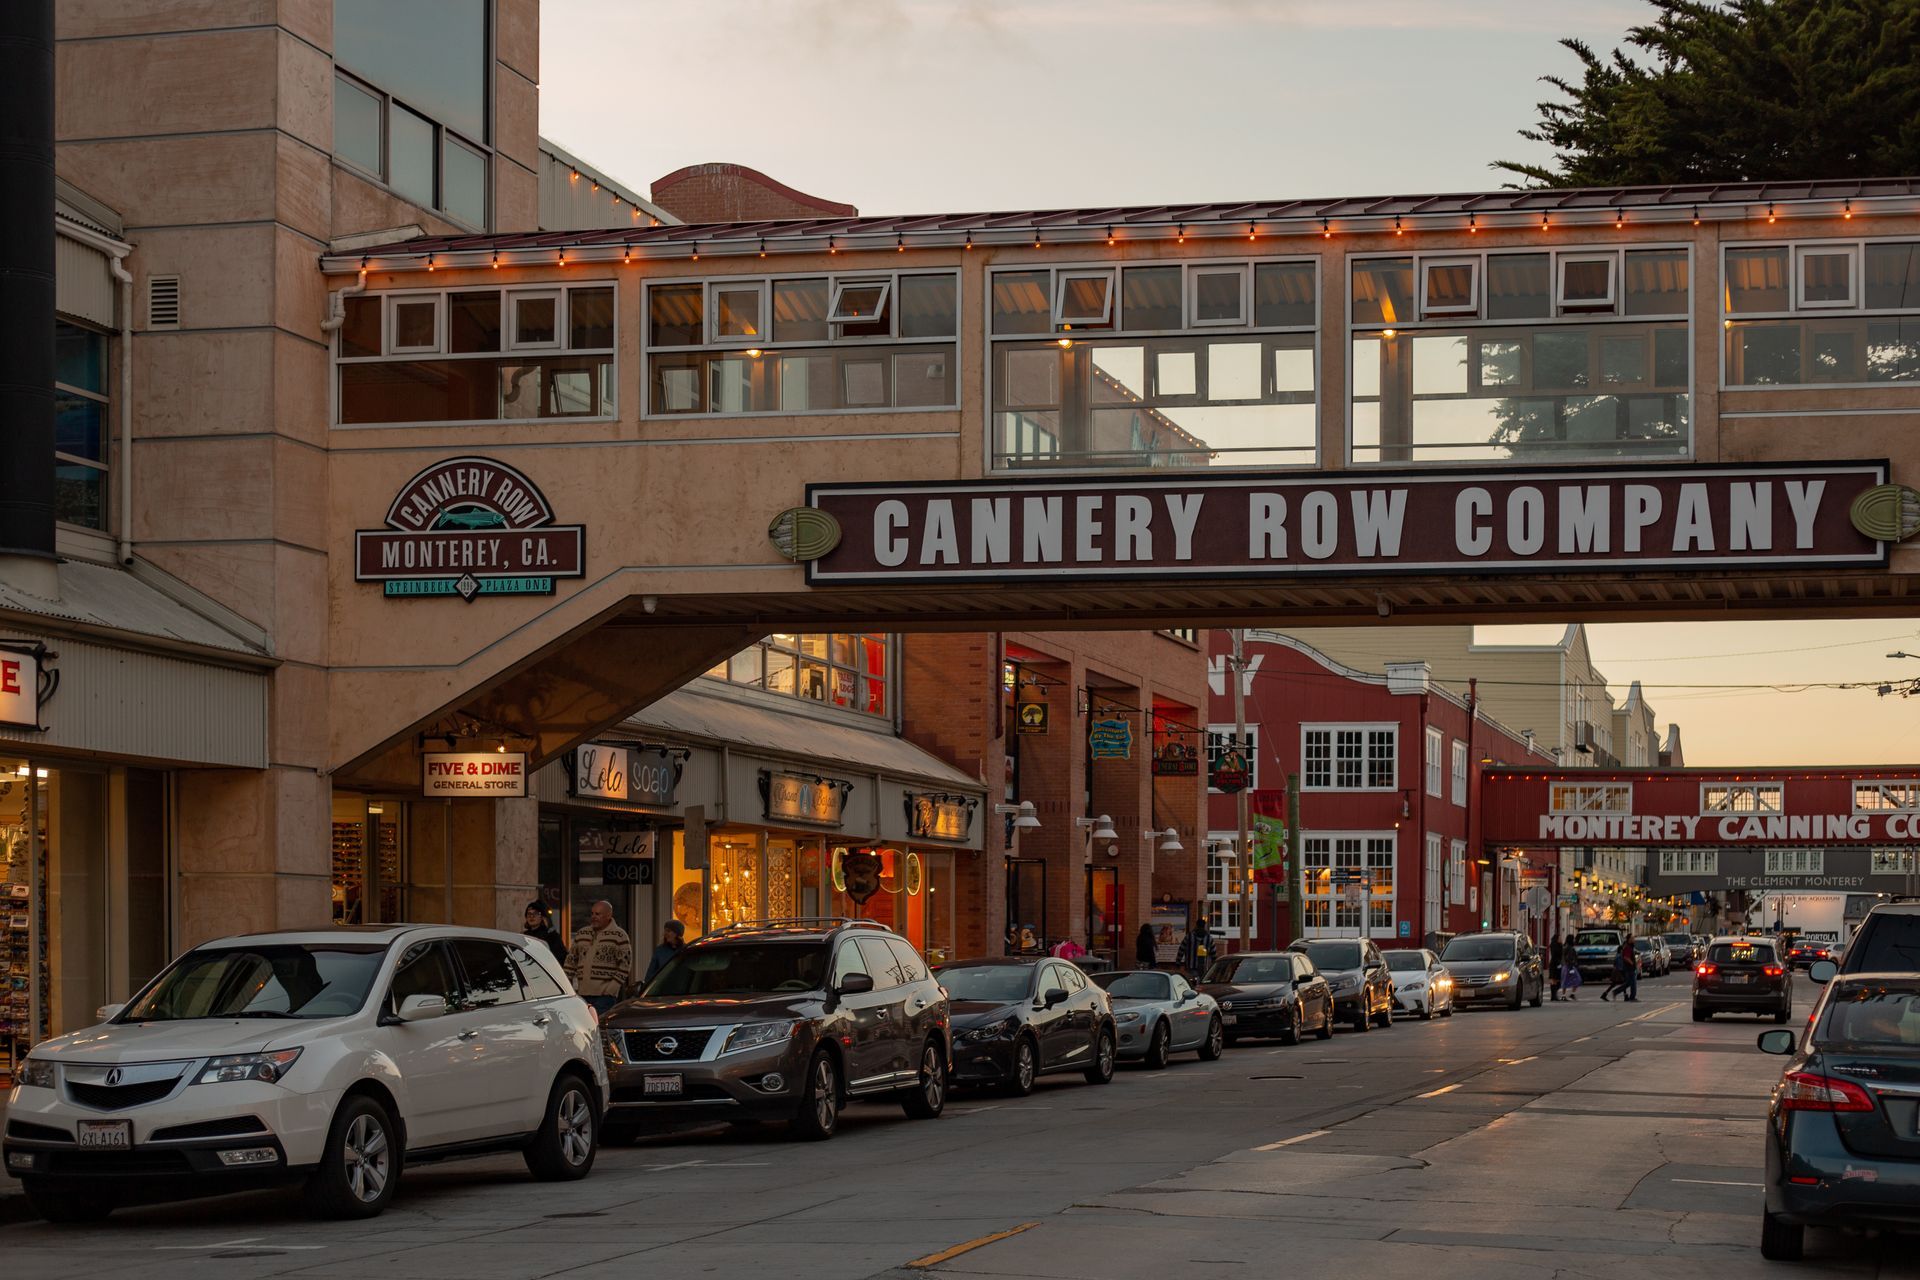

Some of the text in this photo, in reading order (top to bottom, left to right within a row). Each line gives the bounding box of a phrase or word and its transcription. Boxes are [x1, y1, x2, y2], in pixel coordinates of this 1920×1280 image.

[400, 468, 539, 527] CANNERY ROW
[872, 480, 1828, 568] CANNERY ROW COMPANY
[381, 537, 558, 570] MONTEREY, CA.
[388, 581, 451, 594] STEINBECK
[486, 580, 520, 592] PLAZA
[525, 578, 548, 591] ONE
[427, 762, 522, 776] FIVE & DIME
[579, 748, 669, 803] Lola soap
[433, 780, 519, 790] GENERAL STORE
[1538, 814, 1701, 840] MONTEREY
[1717, 814, 1872, 841] CANNING
[606, 834, 648, 855] Lola
[1725, 876, 1865, 887] THE CLEMENT MONTEREY
